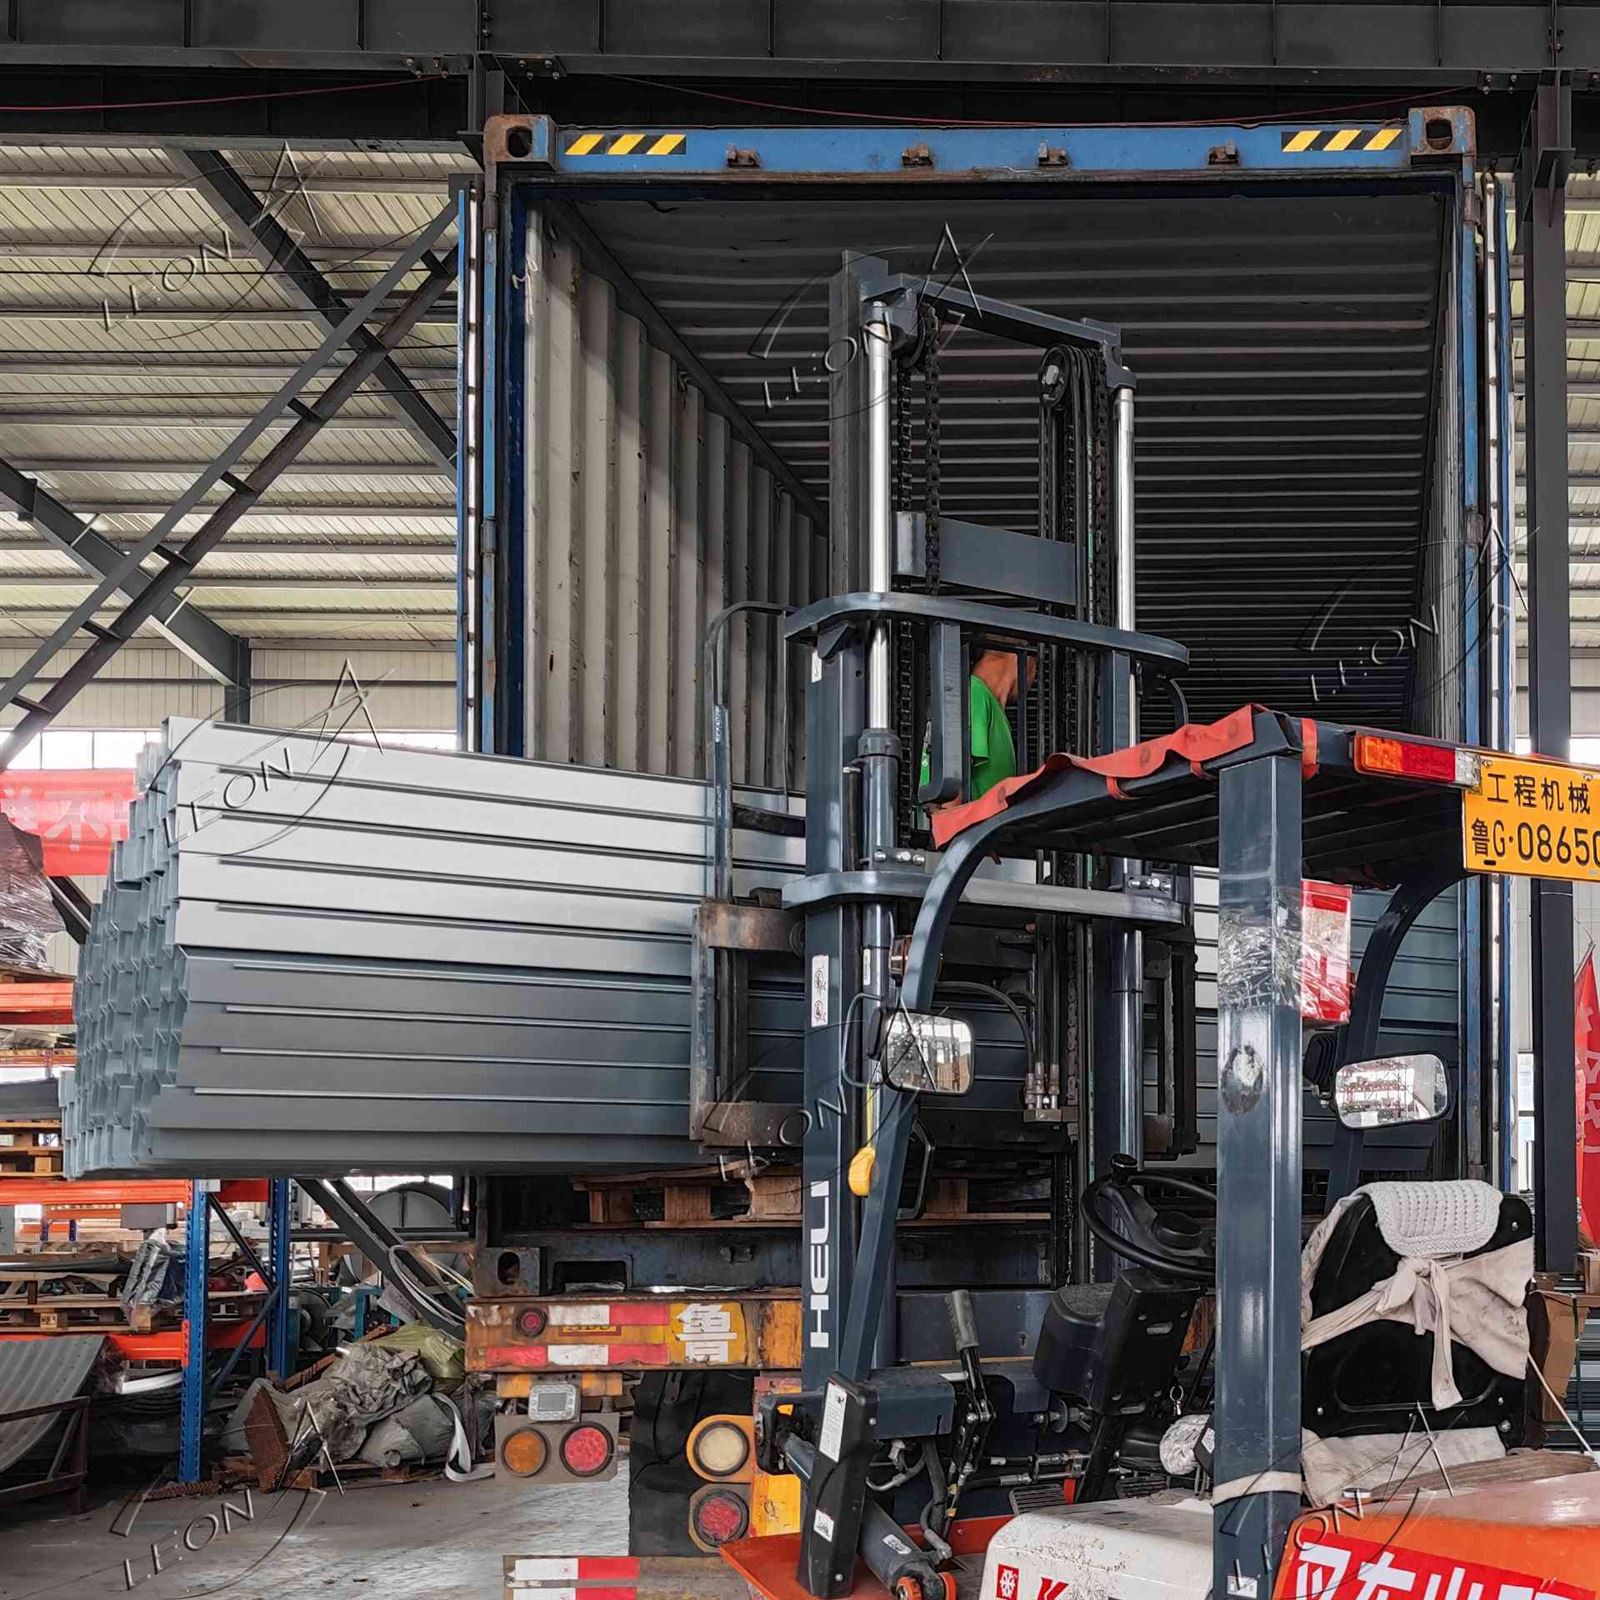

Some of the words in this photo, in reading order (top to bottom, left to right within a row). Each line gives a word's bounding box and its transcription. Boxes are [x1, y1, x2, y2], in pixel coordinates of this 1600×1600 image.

[1487, 773, 1591, 815] 工程机械
[810, 1180, 830, 1349] HELI
